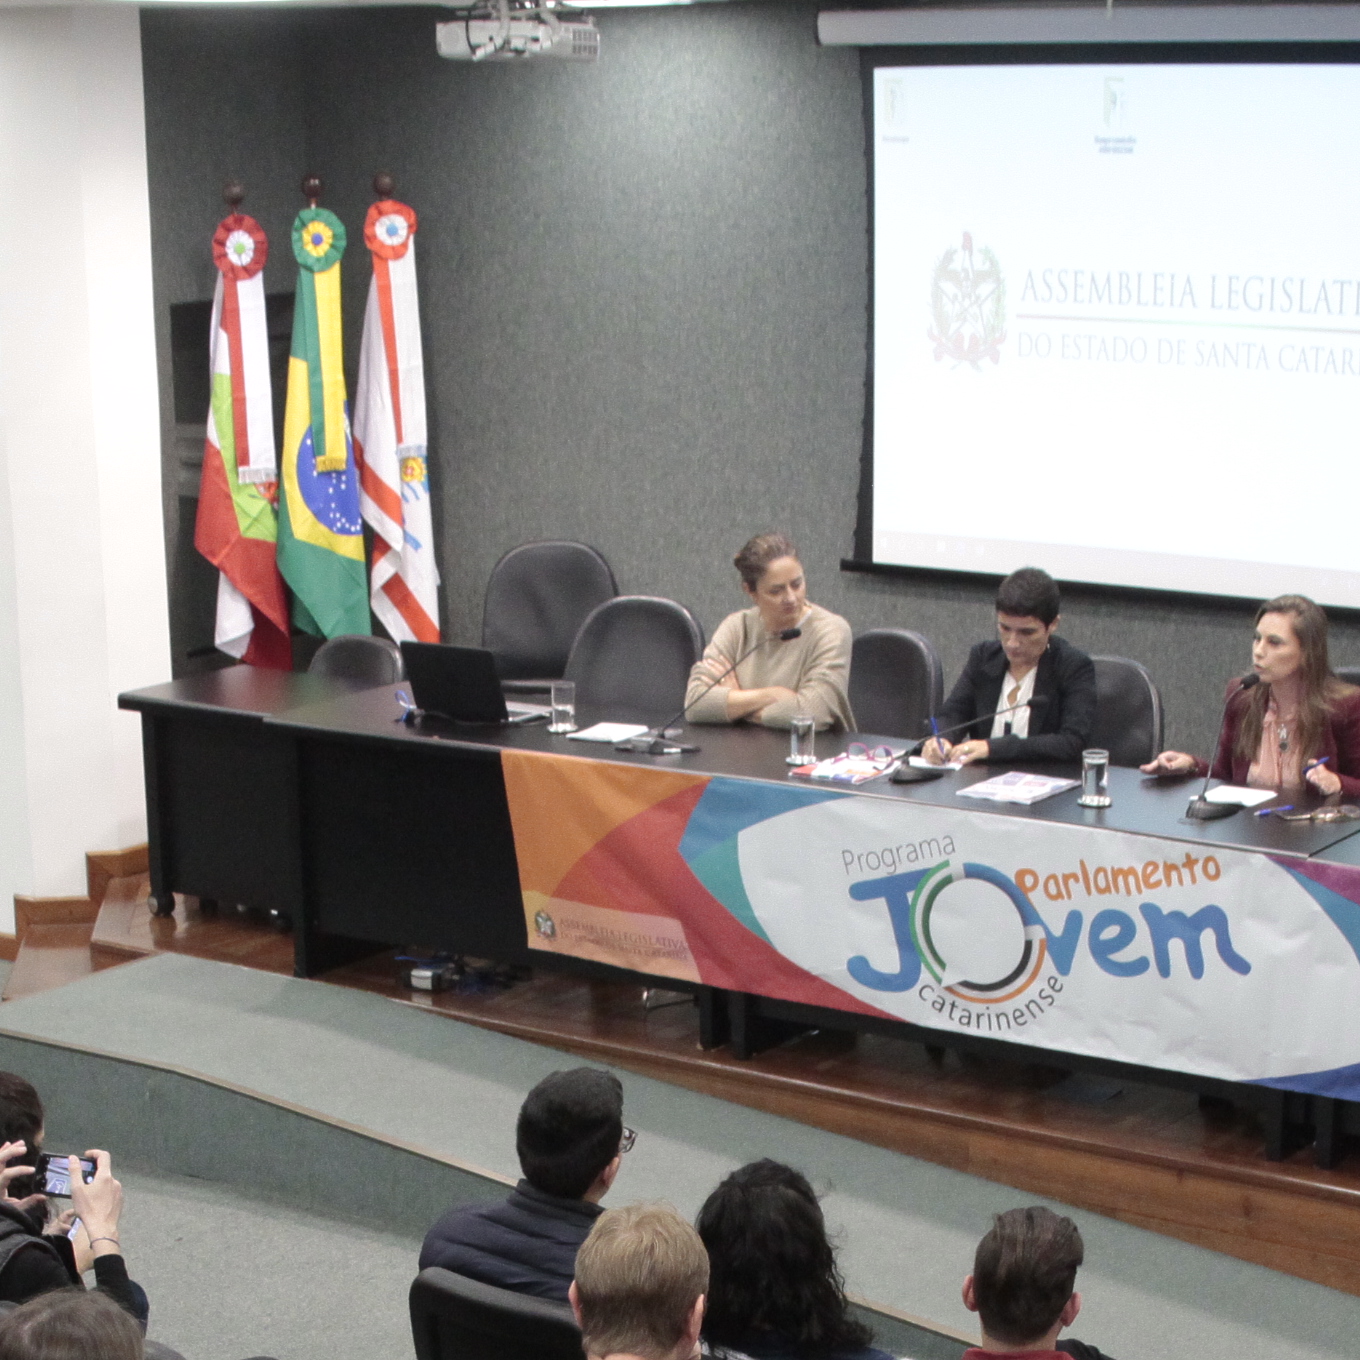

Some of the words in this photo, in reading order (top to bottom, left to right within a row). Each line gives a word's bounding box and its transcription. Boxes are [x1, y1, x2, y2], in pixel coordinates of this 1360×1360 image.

[1021, 268, 1198, 309] ASSEMBLEIA
[1018, 331, 1052, 359] DO
[1061, 333, 1148, 364] ESTADO
[1157, 337, 1186, 366] DE
[1194, 339, 1270, 371] SANTA
[841, 834, 956, 876] Programa
[1014, 852, 1222, 901] Parlamento
[918, 975, 1065, 1032] catarinense
